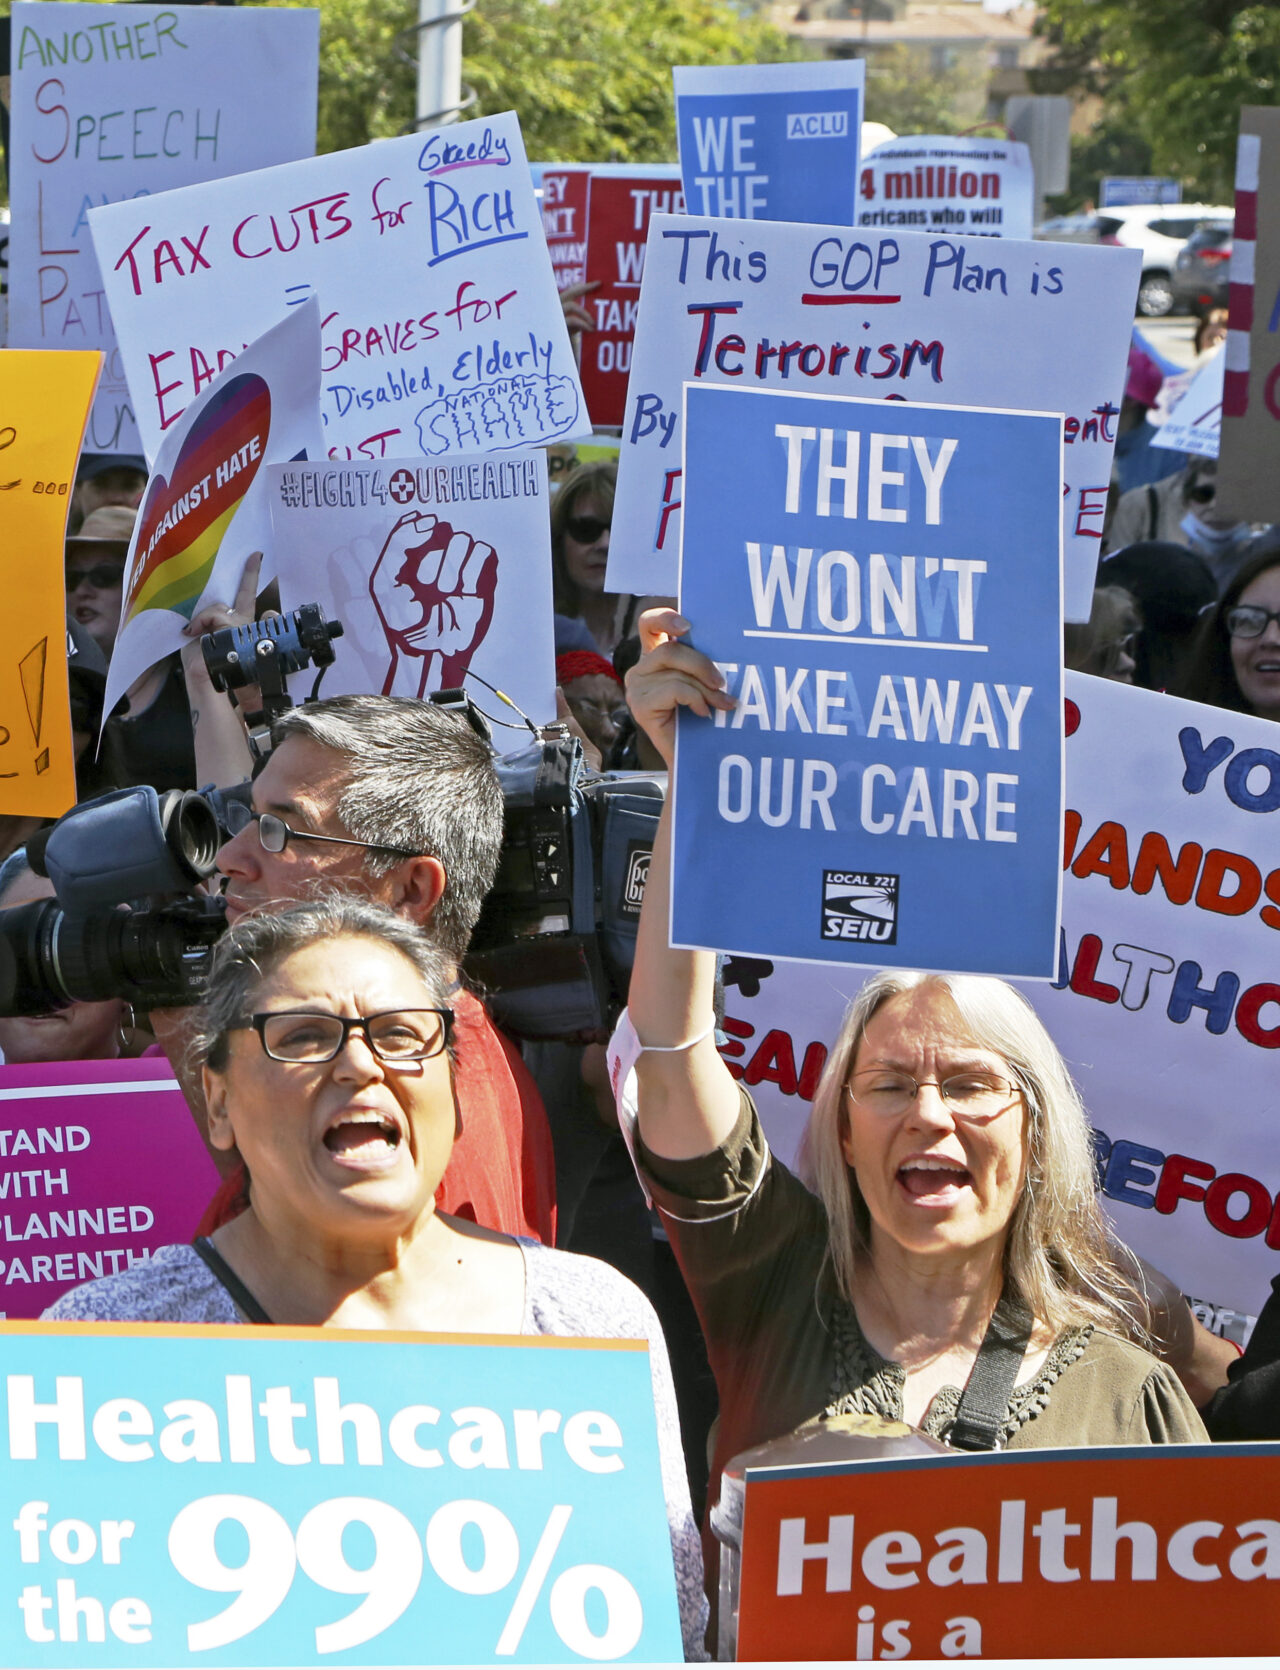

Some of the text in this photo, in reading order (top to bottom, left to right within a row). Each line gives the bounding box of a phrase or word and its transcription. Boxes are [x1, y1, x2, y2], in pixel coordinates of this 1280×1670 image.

[18, 12, 189, 71] ANOTHER
[32, 79, 221, 164] SPEECH
[418, 128, 511, 172] Greedy
[693, 115, 756, 173] WE
[790, 113, 846, 138] ACLU
[694, 175, 769, 220] THE
[884, 165, 1001, 199] million
[114, 226, 212, 296] TAX
[232, 192, 352, 259] CUTS
[372, 177, 413, 235] for
[425, 180, 516, 256] RICH
[859, 206, 1003, 226] ericans who will
[662, 229, 768, 284] This
[809, 238, 900, 292] GOP
[923, 240, 1009, 298] Plan
[1030, 262, 1065, 296] is
[445, 281, 517, 331] for
[594, 299, 640, 332] TAK
[452, 332, 553, 386] Elderly
[598, 340, 634, 373] OU
[687, 301, 944, 383] Terrorism
[429, 386, 575, 456] SHAME
[444, 376, 538, 414] NATIONAL
[629, 393, 678, 449] By
[147, 474, 212, 560] AGAINST
[216, 435, 261, 489] HATE
[774, 423, 959, 526] THEY
[745, 541, 988, 641] WON'T
[867, 675, 1034, 751] AWAY
[718, 754, 1020, 843] OUR CARE
[1178, 726, 1280, 813] YO
[826, 873, 896, 888] LOCAL 721
[824, 917, 894, 941] SEIU
[6, 1375, 625, 1474] Healthcare
[13, 1501, 135, 1565] for
[776, 1496, 1280, 1597] Healthca
[167, 1493, 644, 1661] 99%
[18, 1578, 153, 1644] the
[856, 1605, 913, 1661] is
[940, 1616, 983, 1658] a
